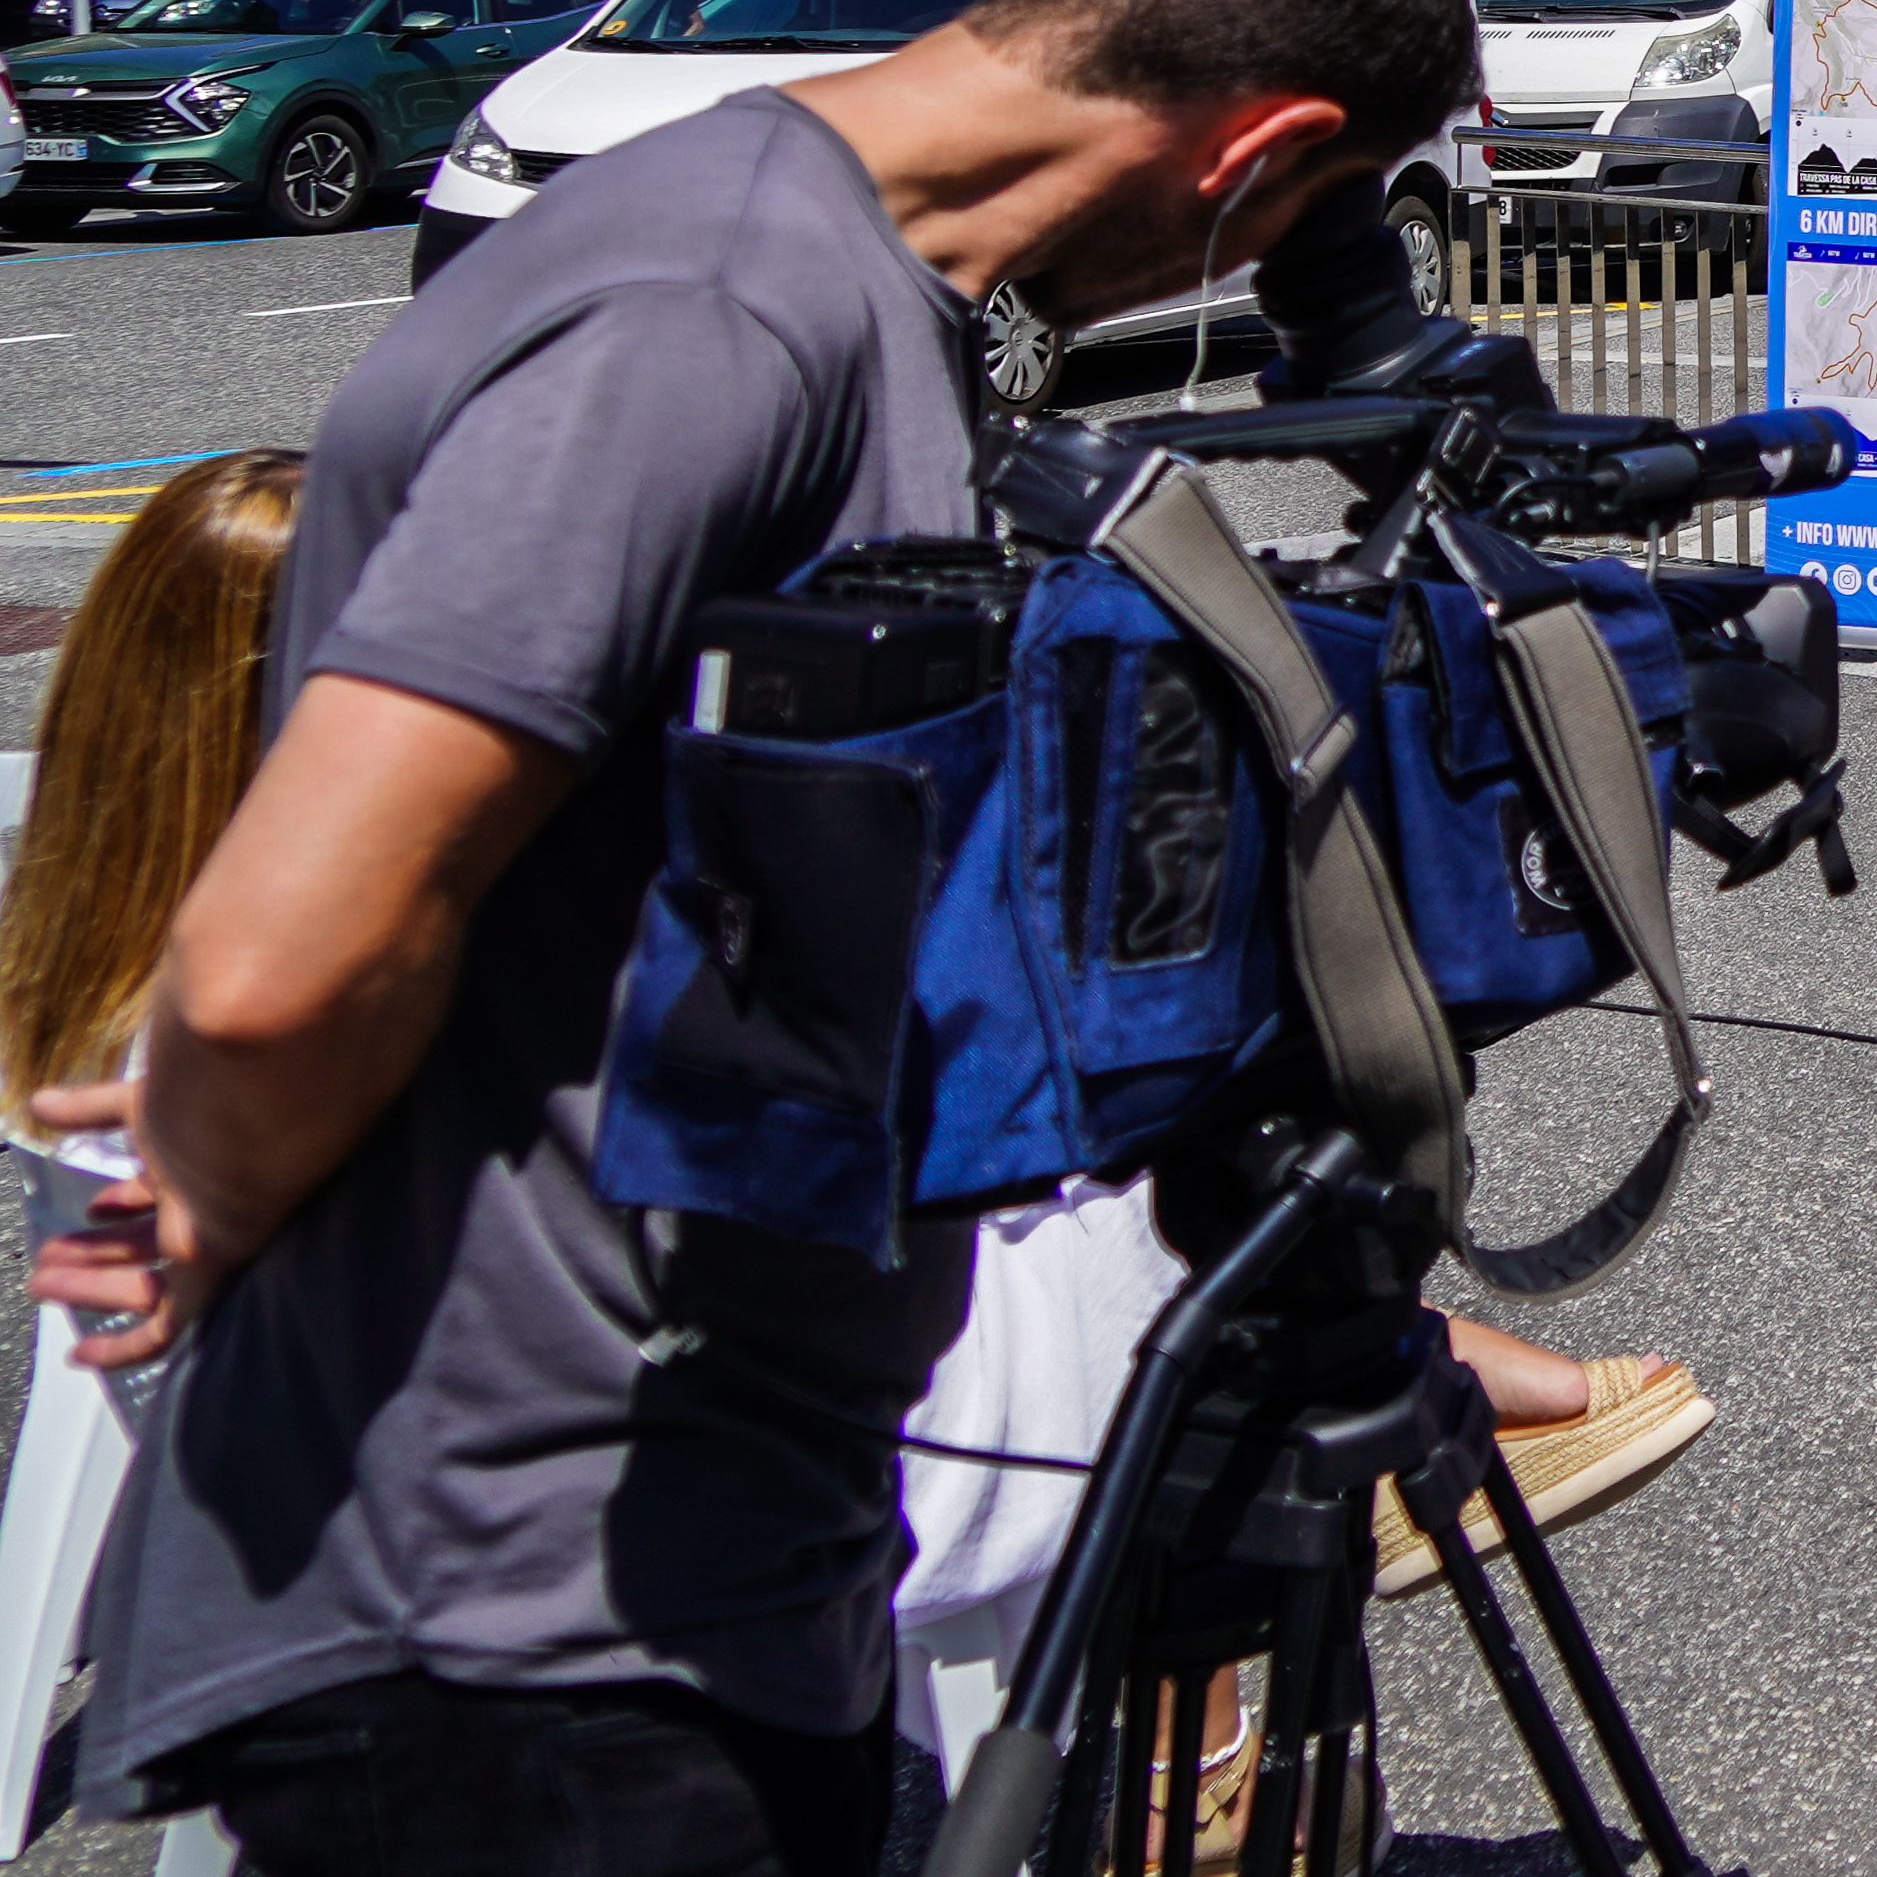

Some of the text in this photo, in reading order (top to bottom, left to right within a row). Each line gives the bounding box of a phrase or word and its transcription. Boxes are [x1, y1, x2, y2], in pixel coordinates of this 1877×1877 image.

[1800, 210, 1812, 234] 6
[1816, 211, 1844, 236] KM
[1796, 521, 1833, 546] INFO
